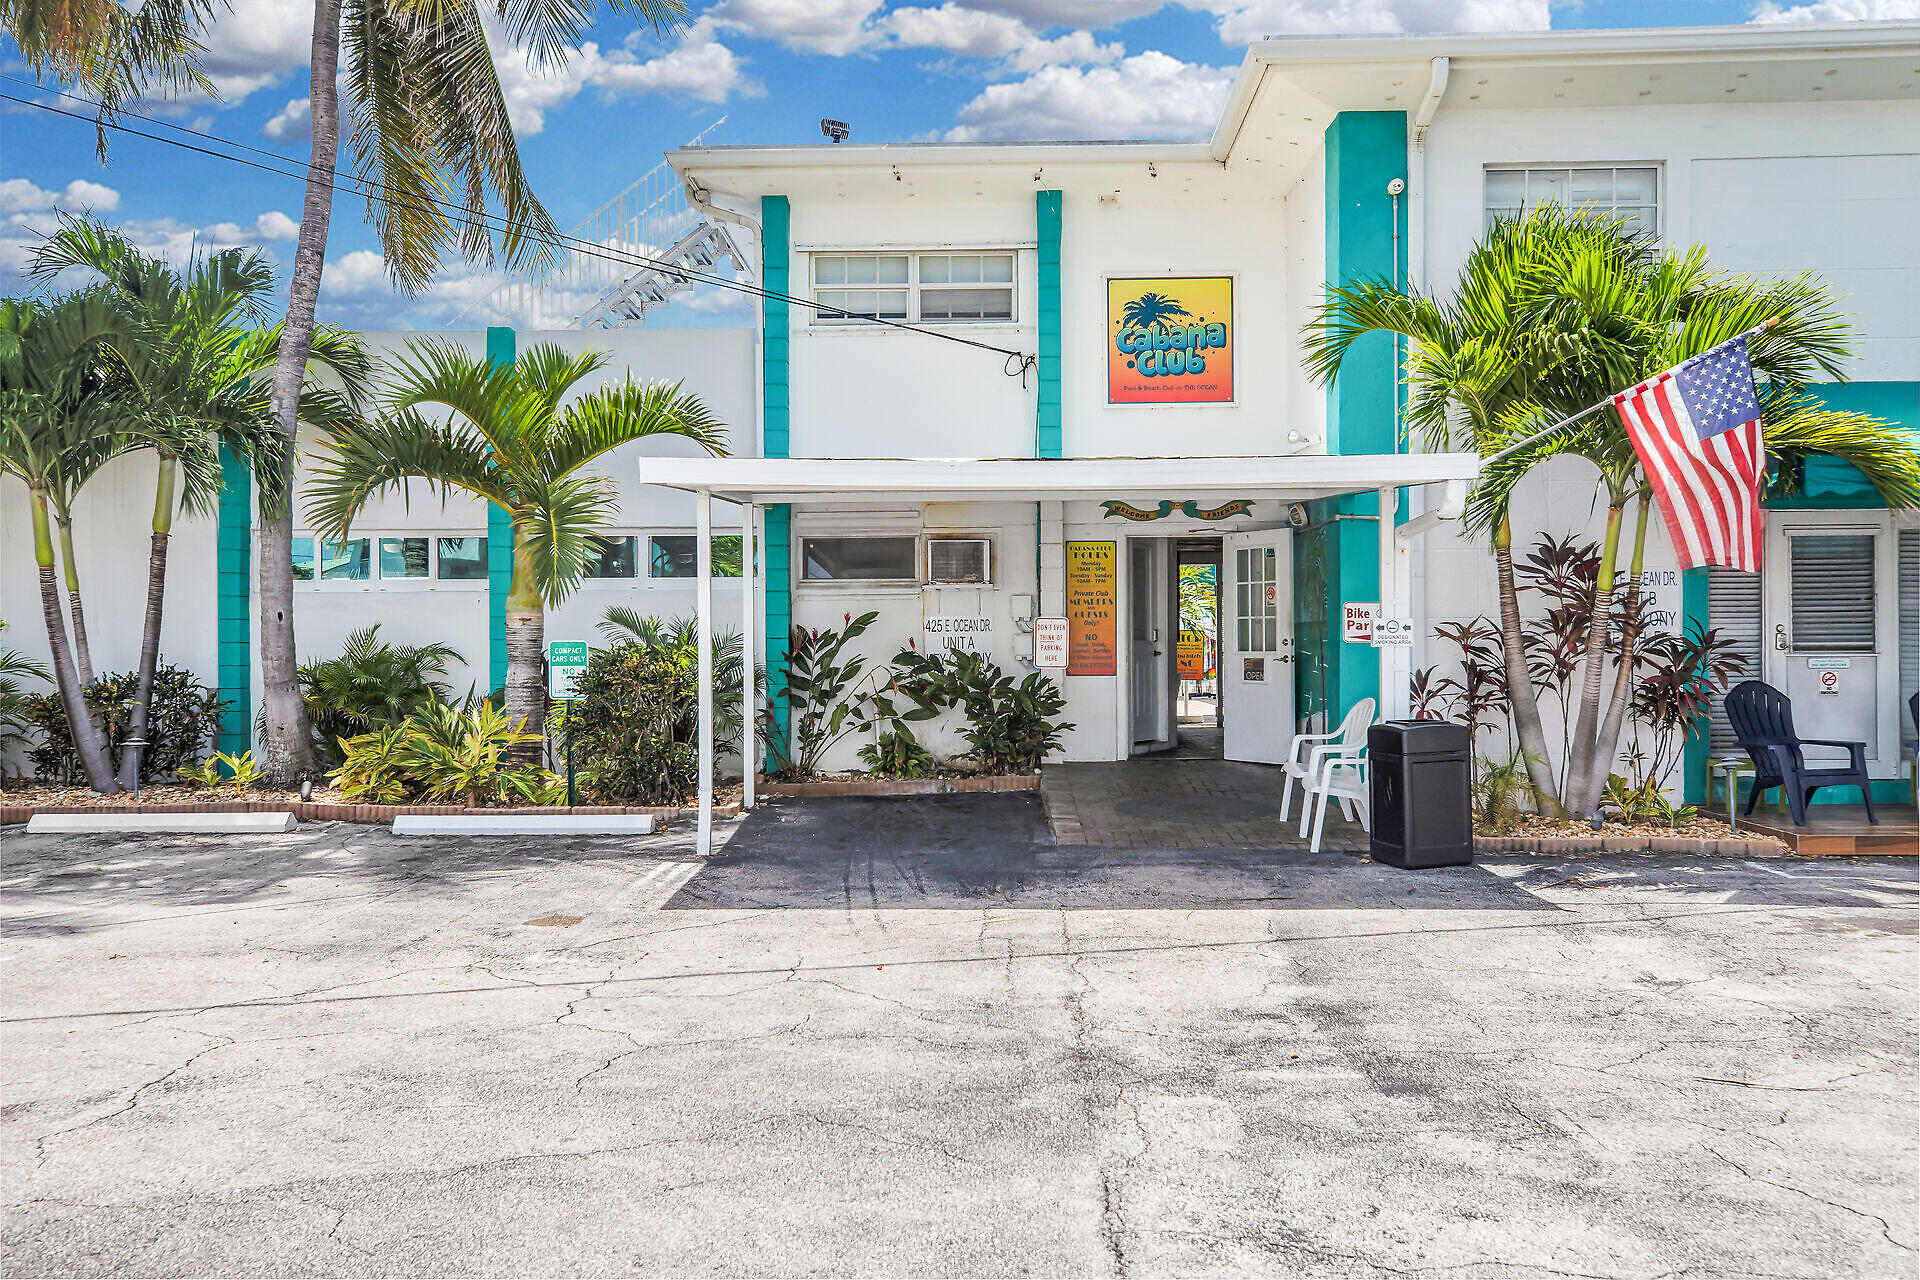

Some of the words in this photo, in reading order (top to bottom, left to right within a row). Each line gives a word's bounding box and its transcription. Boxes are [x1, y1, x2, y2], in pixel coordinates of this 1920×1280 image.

[1116, 322, 1226, 354] Cabana
[1136, 347, 1206, 377] Club
[1114, 505, 1150, 519] WELCOME
[1207, 504, 1240, 518] FRIENDS
[1663, 571, 1678, 586] DR.
[1649, 591, 1657, 606] B
[1346, 608, 1370, 619] Bike
[926, 619, 943, 632] 425
[954, 619, 979, 632] OCEAN
[980, 619, 992, 632] DR.
[1346, 620, 1370, 631] Par
[943, 637, 966, 649] UNIT
[968, 637, 975, 649] A
[1085, 633, 1098, 641] NO
[1245, 671, 1264, 680] OPEN
